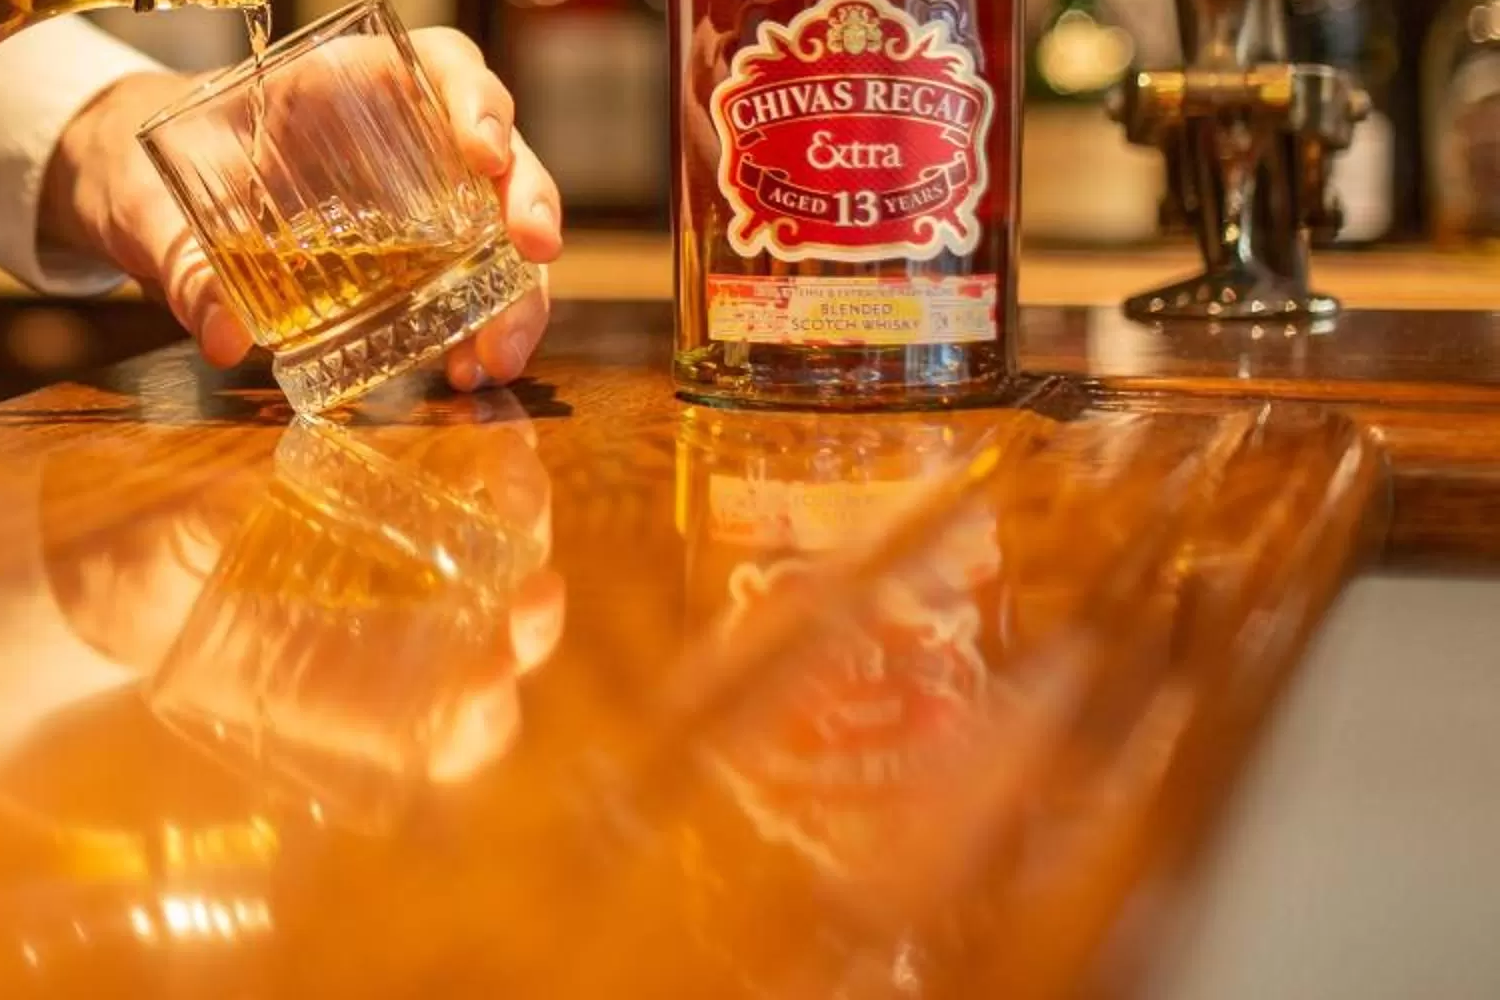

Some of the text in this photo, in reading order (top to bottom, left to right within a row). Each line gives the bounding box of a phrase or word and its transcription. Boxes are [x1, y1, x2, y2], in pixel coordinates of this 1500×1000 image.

[730, 80, 971, 132] CHIVAS REGAL
[806, 130, 903, 170] Extra
[768, 184, 945, 227] AGED 13 YEARS
[791, 318, 860, 331] SCOTCH
[861, 318, 921, 331] WHISKY
[820, 303, 894, 316] BLENDED
